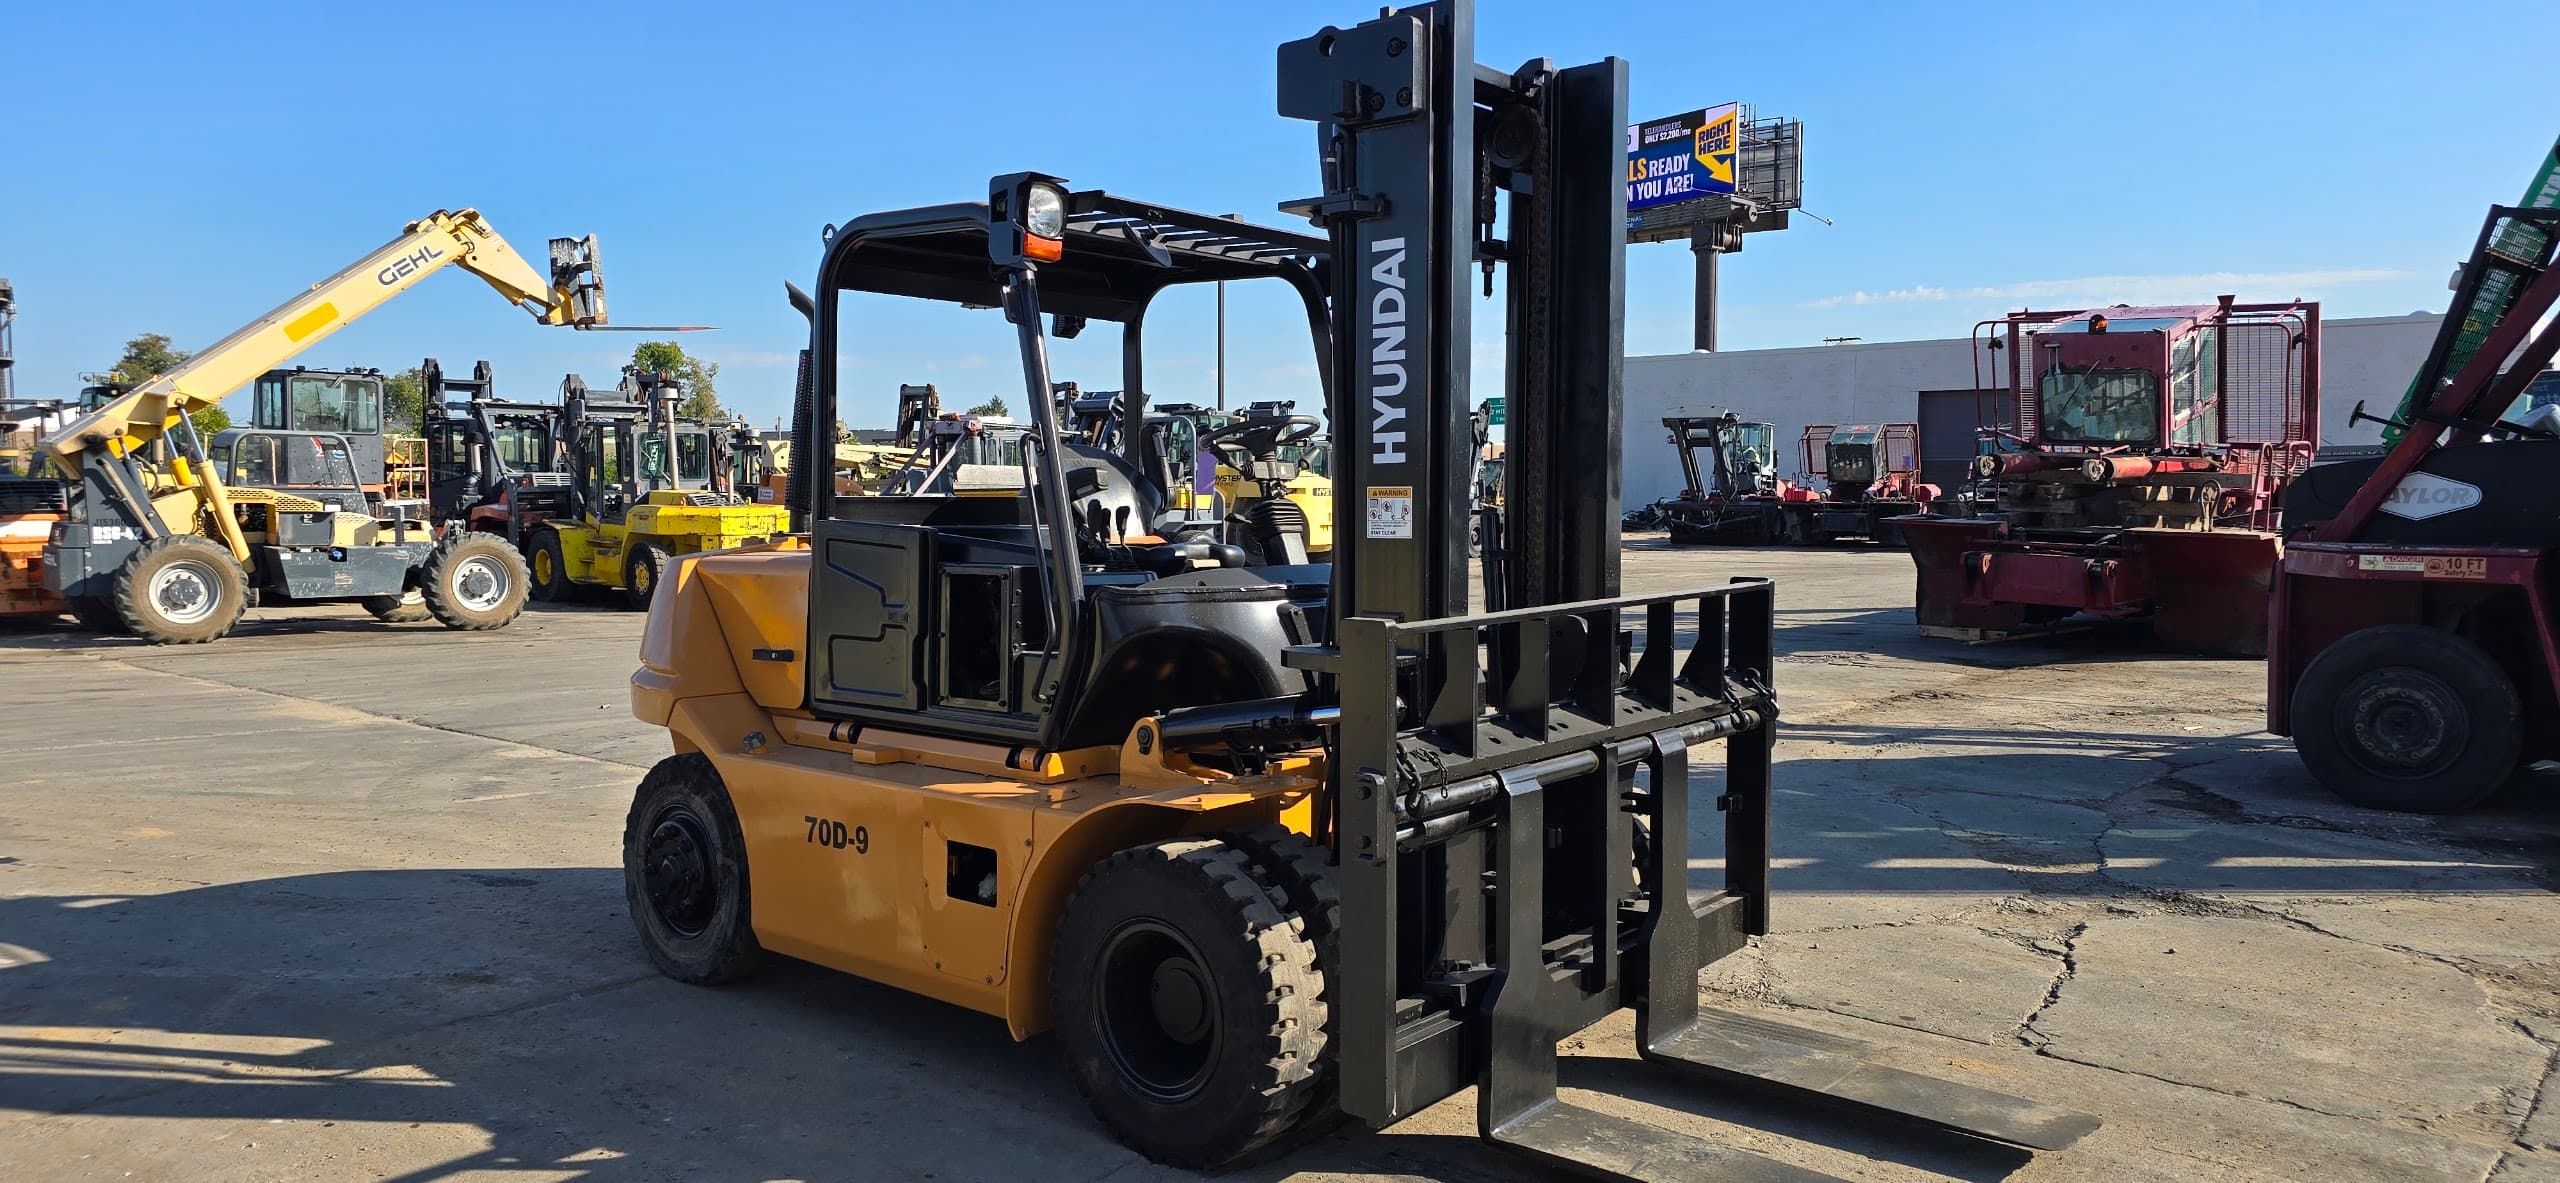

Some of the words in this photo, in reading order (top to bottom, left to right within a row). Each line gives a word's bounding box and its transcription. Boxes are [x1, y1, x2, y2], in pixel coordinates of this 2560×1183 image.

[1645, 133, 1659, 144] ONLY
[1699, 119, 1733, 144] RIGHT
[1699, 135, 1731, 156] HERE
[1627, 157, 1648, 182] LS
[1649, 152, 1691, 178] READY
[1637, 179, 1662, 201] YOU
[1665, 173, 1694, 196] ARE!
[377, 245, 444, 286] GEHL
[1372, 237, 1407, 464] HYUNDAI
[1378, 489, 1408, 497] WARNING
[2382, 487, 2474, 504] AYLOR
[2444, 569, 2467, 578] Safety
[2446, 557, 2463, 570] 10
[2467, 558, 2485, 570] FT
[804, 815, 869, 855] 70D-9
